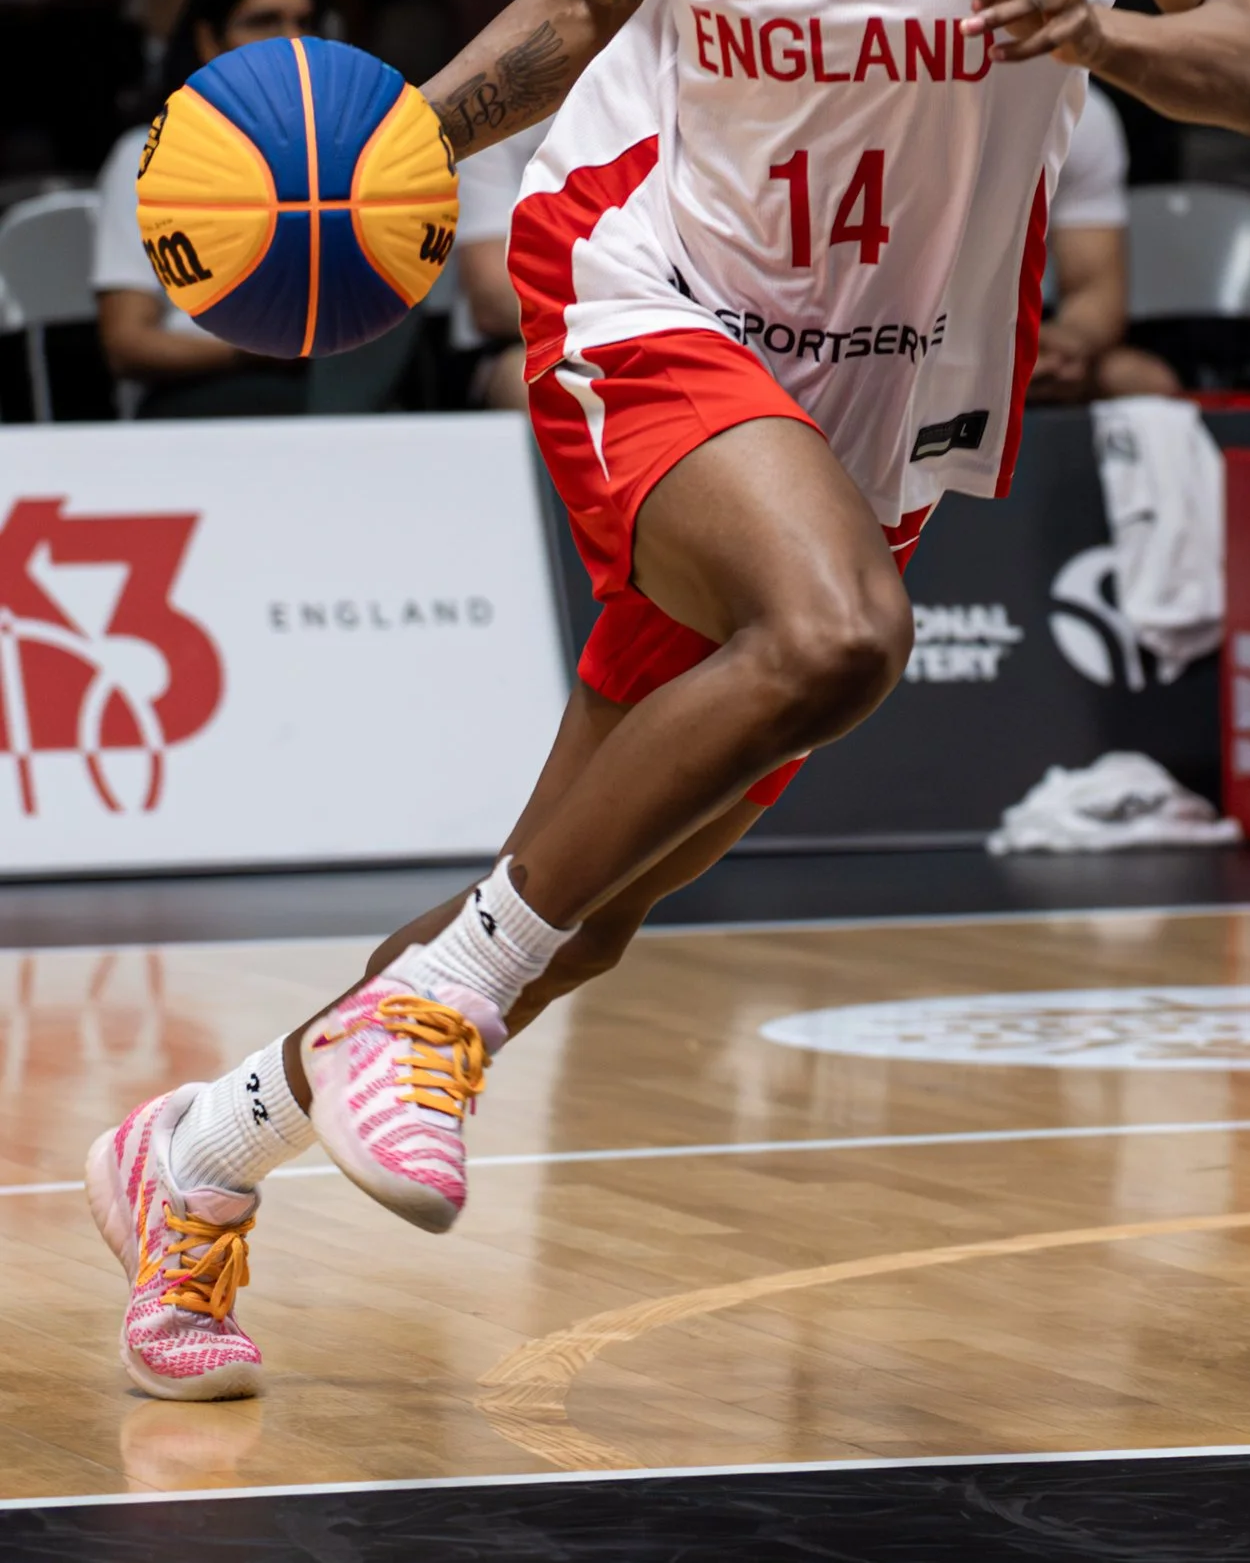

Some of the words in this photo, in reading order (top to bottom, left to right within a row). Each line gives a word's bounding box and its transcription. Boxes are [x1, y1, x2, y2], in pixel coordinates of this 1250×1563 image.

[691, 5, 994, 83] ENGLAND
[769, 149, 890, 268] 14
[715, 309, 948, 366] SPORTSERE
[269, 595, 496, 633] ENGLAND
